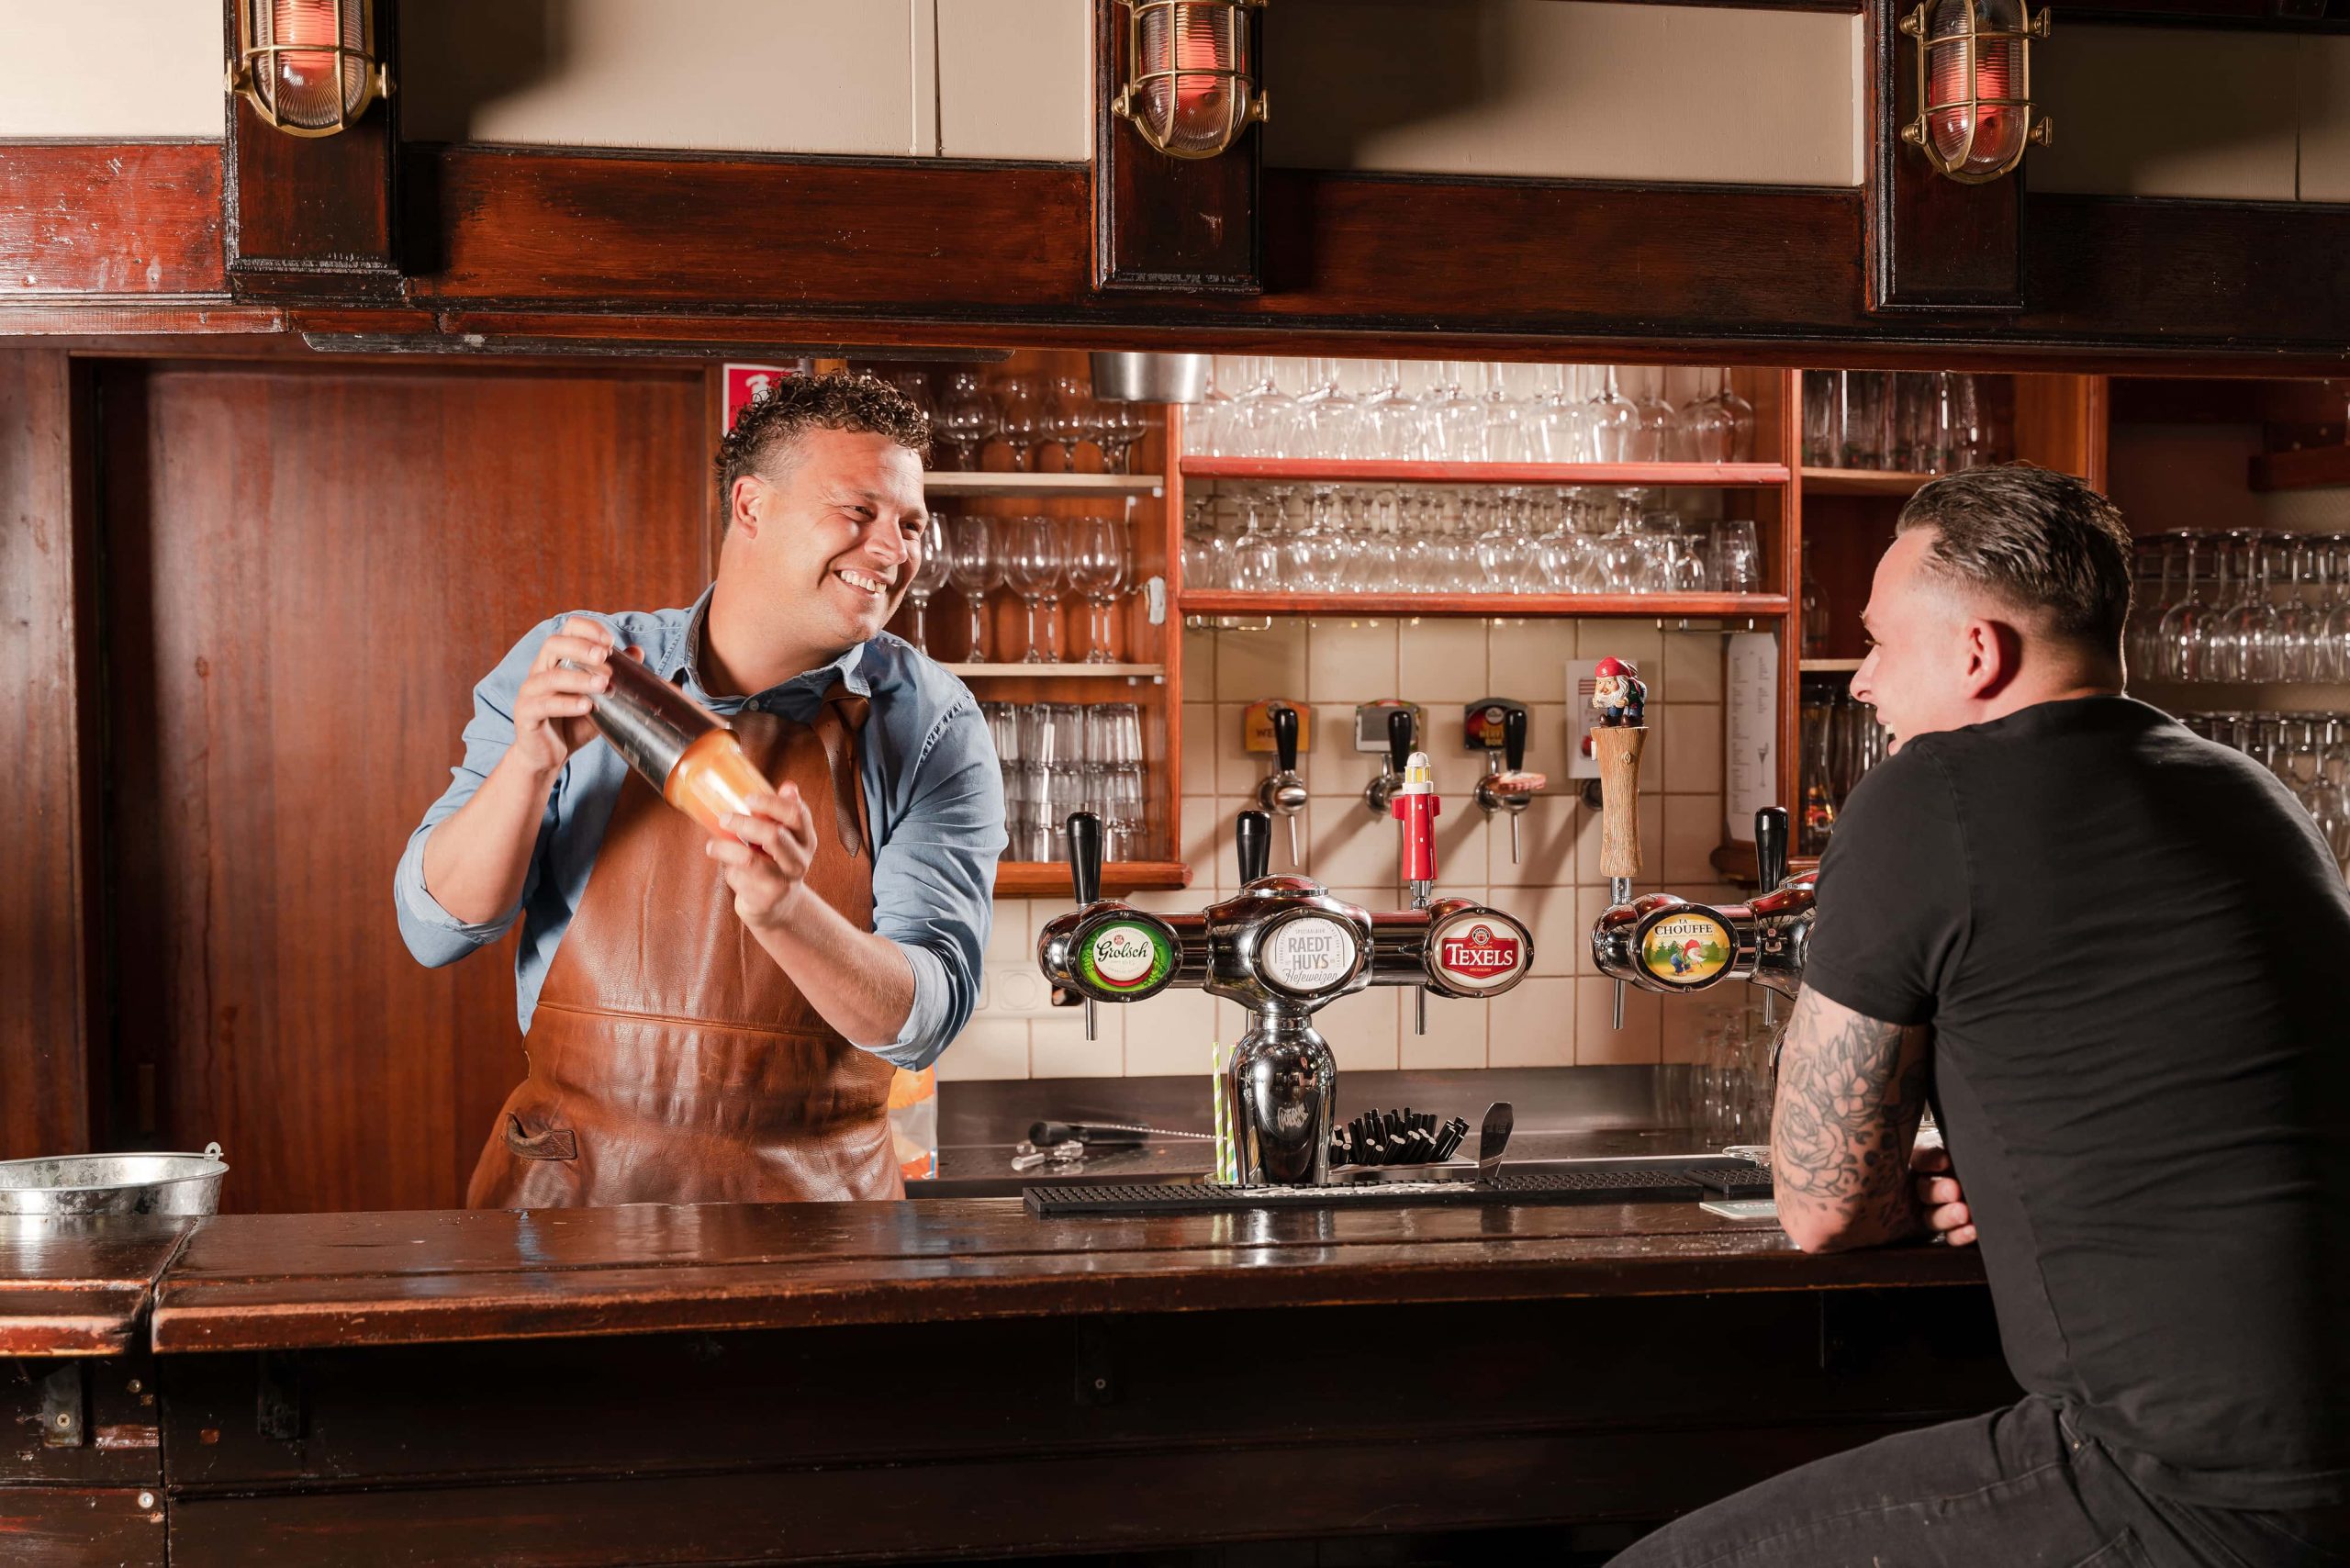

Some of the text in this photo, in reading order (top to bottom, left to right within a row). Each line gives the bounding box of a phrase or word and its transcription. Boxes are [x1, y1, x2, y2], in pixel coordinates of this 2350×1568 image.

[1654, 924, 1713, 935] CHOUFFE
[1096, 940, 1149, 962] Grolsch
[1288, 936, 1332, 953] RAEDT
[1292, 954, 1329, 970] HUYS
[1445, 943, 1514, 966] TEXELS
[1282, 968, 1337, 984] Hefeweizen
